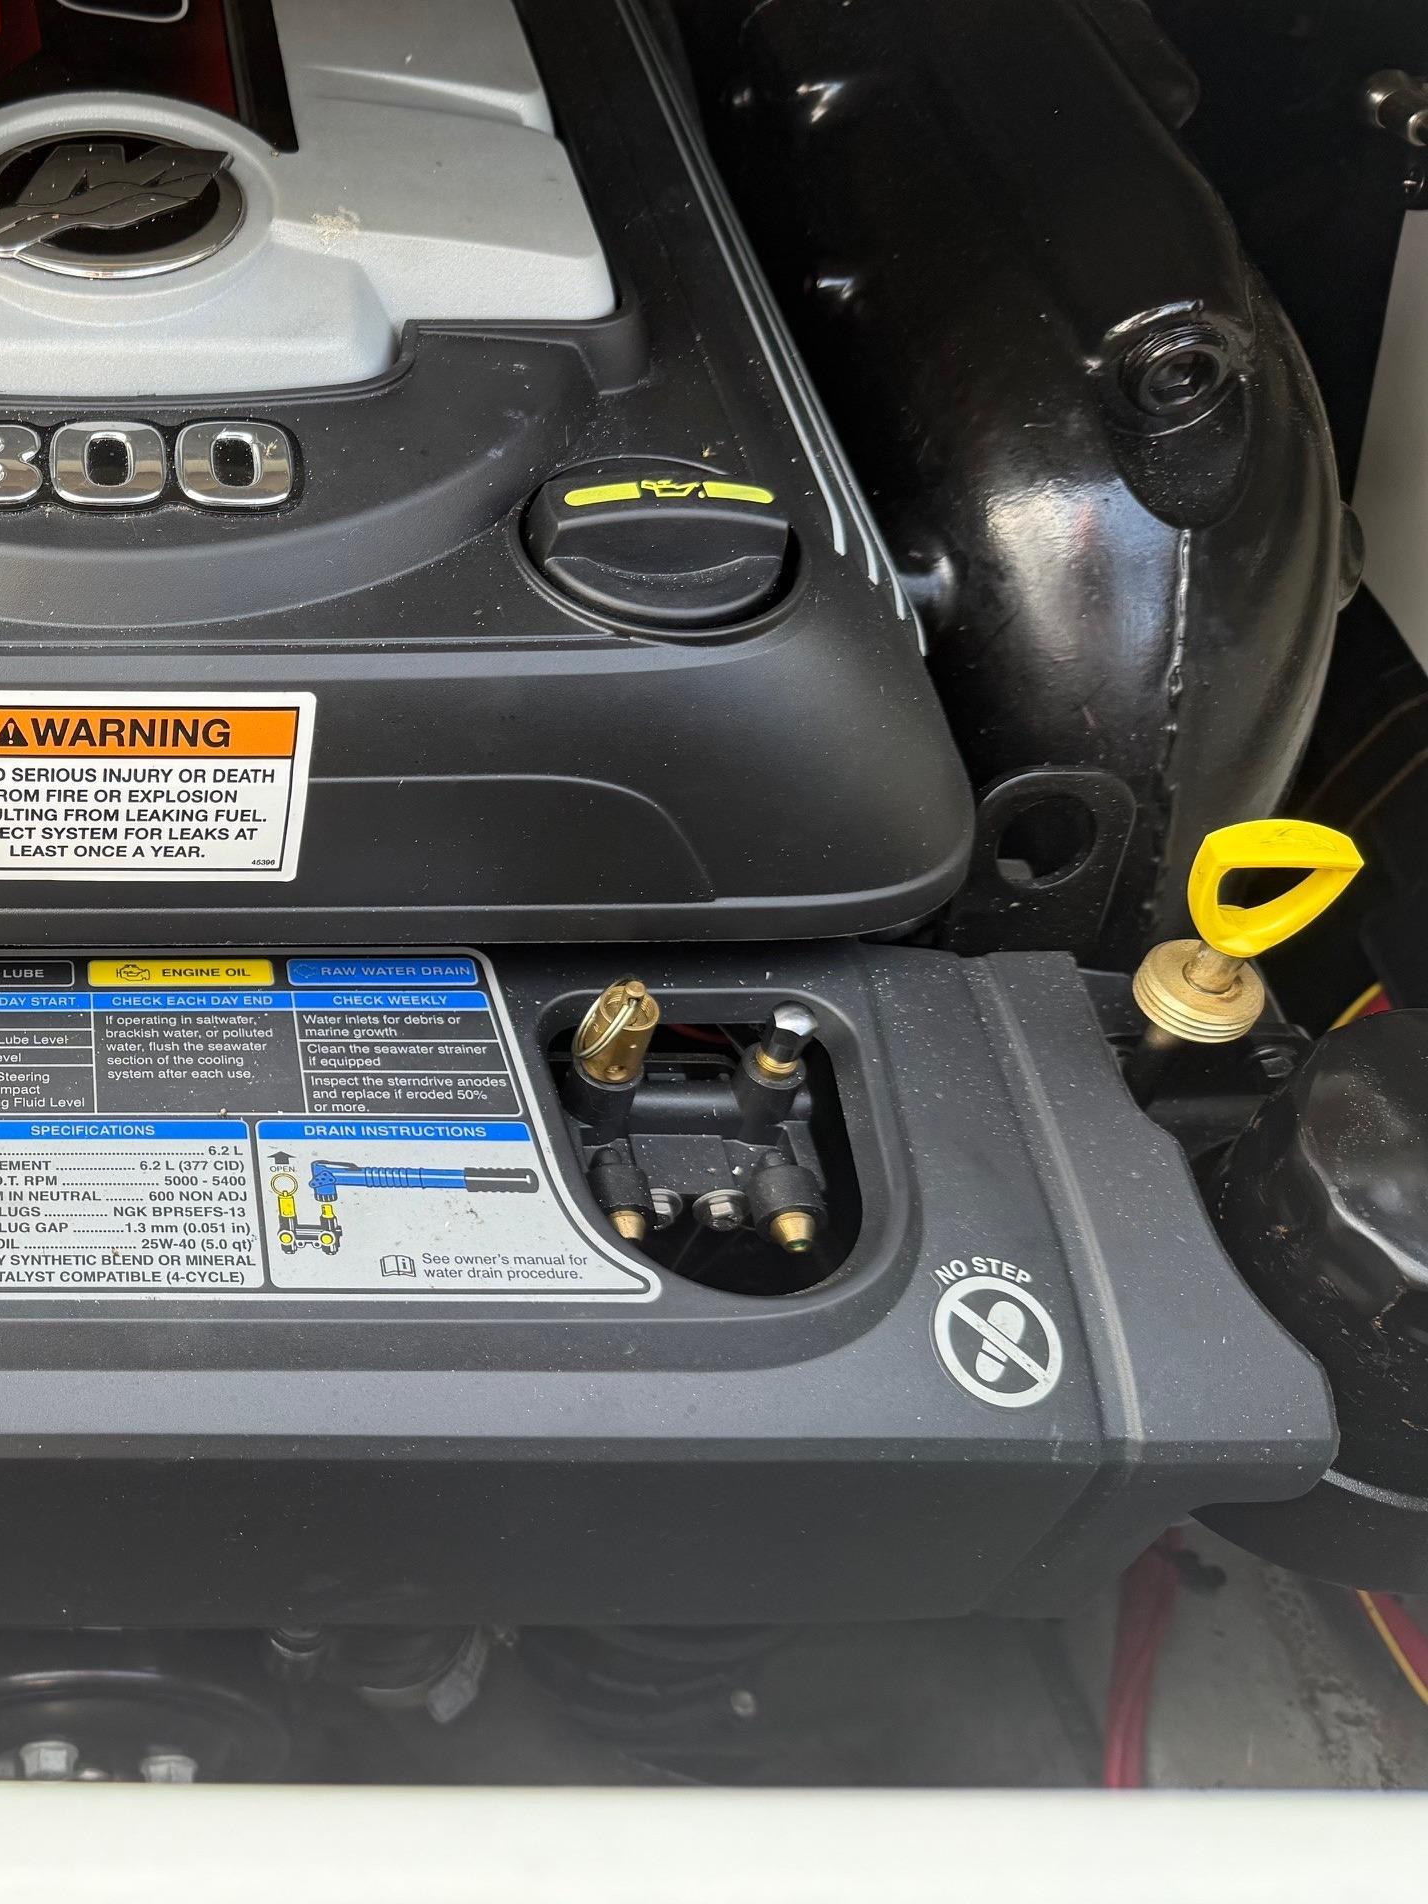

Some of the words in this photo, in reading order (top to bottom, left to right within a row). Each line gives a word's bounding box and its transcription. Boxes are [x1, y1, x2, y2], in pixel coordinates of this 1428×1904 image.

[31, 718, 231, 748] WARNING
[12, 767, 97, 783] SERIOUS
[103, 767, 171, 783] INJURY
[178, 767, 206, 783] OR
[212, 767, 275, 783] DEATH
[46, 790, 87, 803] FIRE
[94, 790, 122, 803] OR
[128, 790, 238, 803] EXPLOSION
[64, 808, 120, 822] FROM
[126, 808, 209, 822] LEAKING
[215, 808, 267, 822] FUEL.
[42, 827, 117, 840] SYSTEM
[124, 827, 161, 840] FOR
[168, 827, 229, 840] LEAKS
[235, 827, 257, 840] AT
[9, 845, 68, 858] LEAST
[74, 845, 126, 858] ONCE
[132, 845, 145, 858] A
[151, 845, 205, 858] YEAR.
[3, 969, 44, 978] LUBE
[162, 969, 220, 977] ENGINE
[225, 969, 250, 977] OIL
[322, 967, 356, 975] RAW
[362, 967, 416, 975] WATER
[421, 967, 470, 975] DRAIN
[0, 997, 25, 1006] DAY
[31, 997, 75, 1006] START
[112, 996, 162, 1005] CHECK
[167, 996, 206, 1005] EACH
[211, 996, 238, 1005] DAY
[244, 996, 272, 1005] END
[333, 996, 383, 1005] CHECK
[387, 996, 447, 1005] WEEKLY
[303, 1015, 341, 1024] Water
[345, 1015, 379, 1024] inlets
[383, 1015, 400, 1024] for
[404, 1015, 443, 1024] debris
[448, 1015, 460, 1024] or
[305, 1027, 349, 1038] marine
[354, 1027, 397, 1038] growth
[34, 1035, 68, 1044] Level
[307, 1044, 344, 1054] Clean
[349, 1044, 369, 1054] the
[374, 1044, 433, 1054] seawater
[437, 1044, 487, 1054] strainer
[309, 1057, 316, 1068] if
[321, 1057, 380, 1068] equipped
[311, 1076, 358, 1087] Inspect
[362, 1076, 382, 1087] the
[387, 1076, 453, 1087] sterndrive
[457, 1076, 506, 1087] anodes
[313, 1089, 337, 1101] and
[342, 1089, 390, 1101] replace
[394, 1089, 402, 1101] if
[406, 1089, 453, 1101] eroded
[457, 1089, 487, 1101] 50%
[14, 1098, 45, 1109] Fluid
[50, 1098, 84, 1109] Level
[314, 1103, 327, 1111] or
[332, 1103, 369, 1111] more.
[31, 1125, 155, 1136] SPECIFICATIONS
[304, 1126, 356, 1137] DRAIN
[361, 1126, 487, 1137] INSTRUCTIONS
[113, 1207, 147, 1217] NGK
[152, 1207, 246, 1217] BPR5EFS-13
[10, 1254, 97, 1266] SYNTHETIC
[102, 1254, 154, 1266] BLEND
[159, 1254, 182, 1266] OR
[185, 1254, 255, 1266] MINERAL
[422, 1254, 449, 1266] See
[454, 1254, 509, 1266] owner's
[513, 1254, 565, 1266] manual
[569, 1254, 587, 1266] for
[424, 1268, 463, 1280] water
[467, 1268, 502, 1280] drain
[507, 1268, 582, 1280] procedure.
[935, 1260, 969, 1284] NO
[972, 1256, 1032, 1283] STEP
[60, 1271, 161, 1284] COMPATIBLE
[166, 1271, 245, 1284] (4-CYCLE)
